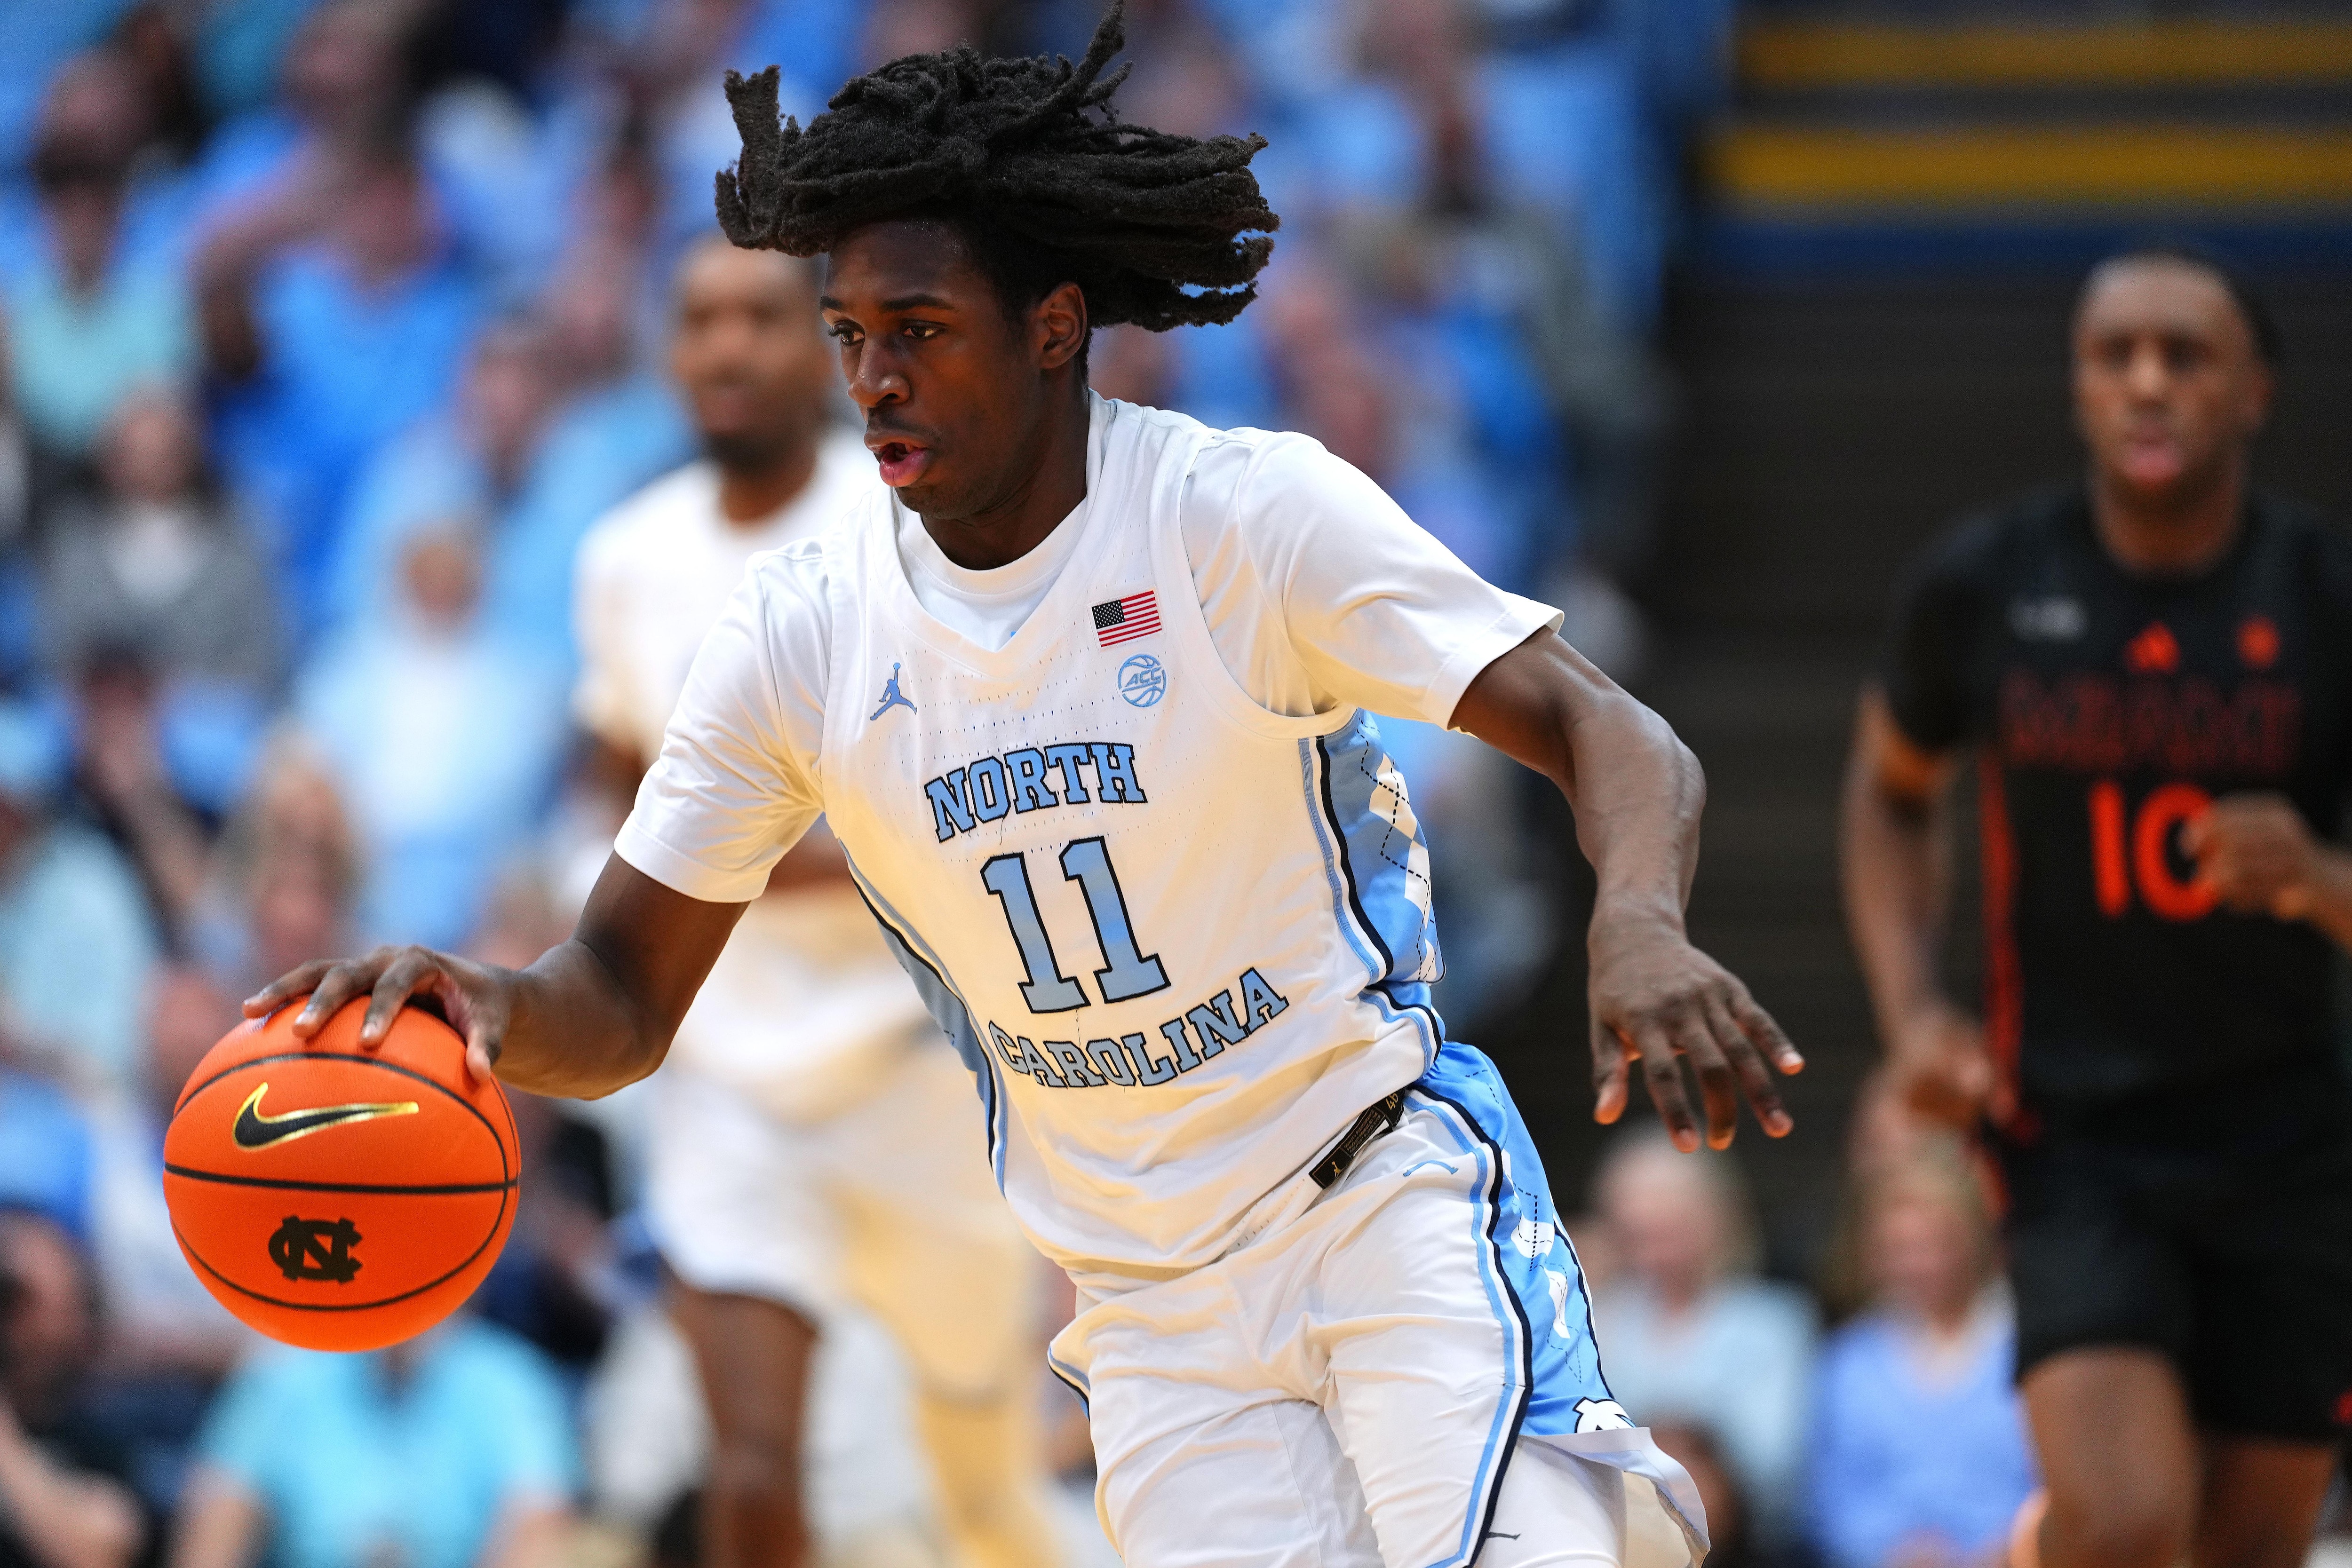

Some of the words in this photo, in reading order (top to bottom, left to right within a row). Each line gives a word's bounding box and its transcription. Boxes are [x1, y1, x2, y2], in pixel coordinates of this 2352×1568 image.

[1125, 666, 1162, 687] ACC
[924, 742, 1148, 843] NORTH
[2088, 780, 2223, 921] 10
[980, 836, 1171, 1014] 11
[989, 966, 1289, 1088] CAROLINA
